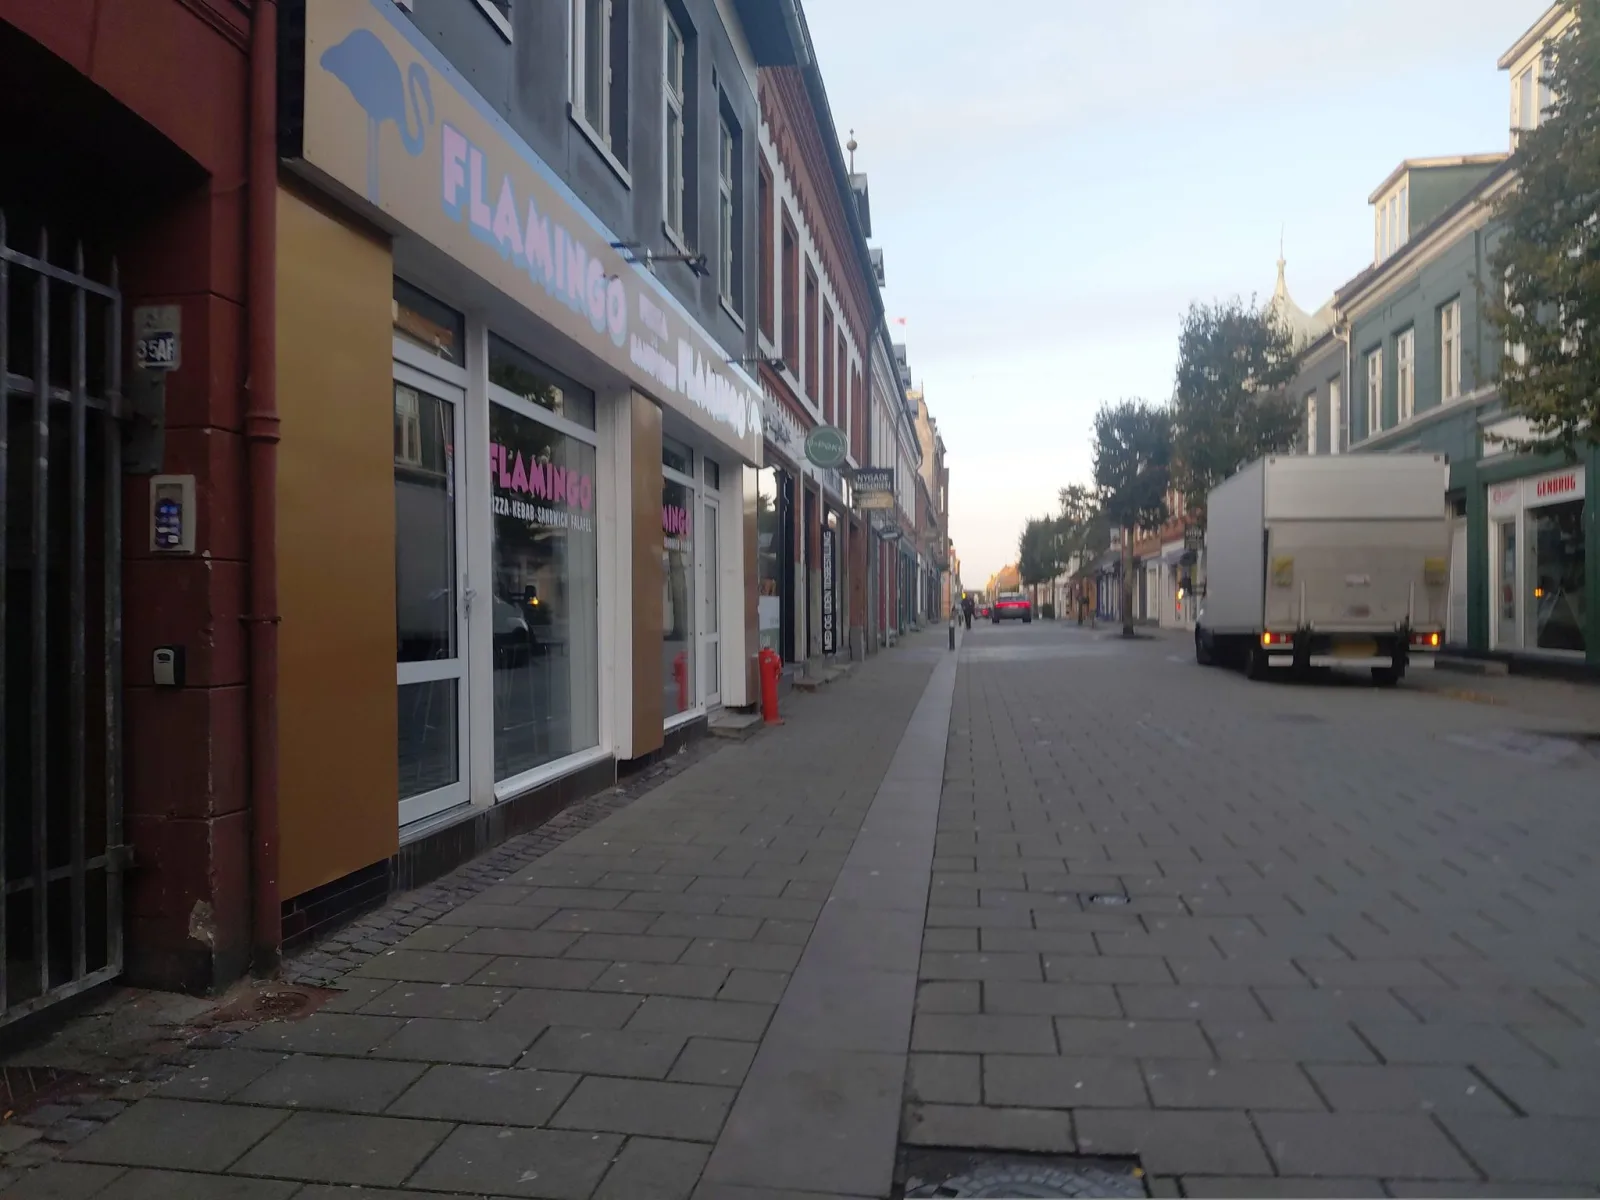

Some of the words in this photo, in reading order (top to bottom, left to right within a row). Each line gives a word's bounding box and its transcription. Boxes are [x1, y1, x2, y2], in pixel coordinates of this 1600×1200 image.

[443, 122, 625, 345] FLAMINGO
[489, 442, 592, 511] FLAMINGO
[857, 472, 889, 482] NYGADE
[1537, 472, 1576, 497] GENBRUG
[512, 499, 535, 521] KEBAB
[823, 615, 832, 629] OG
